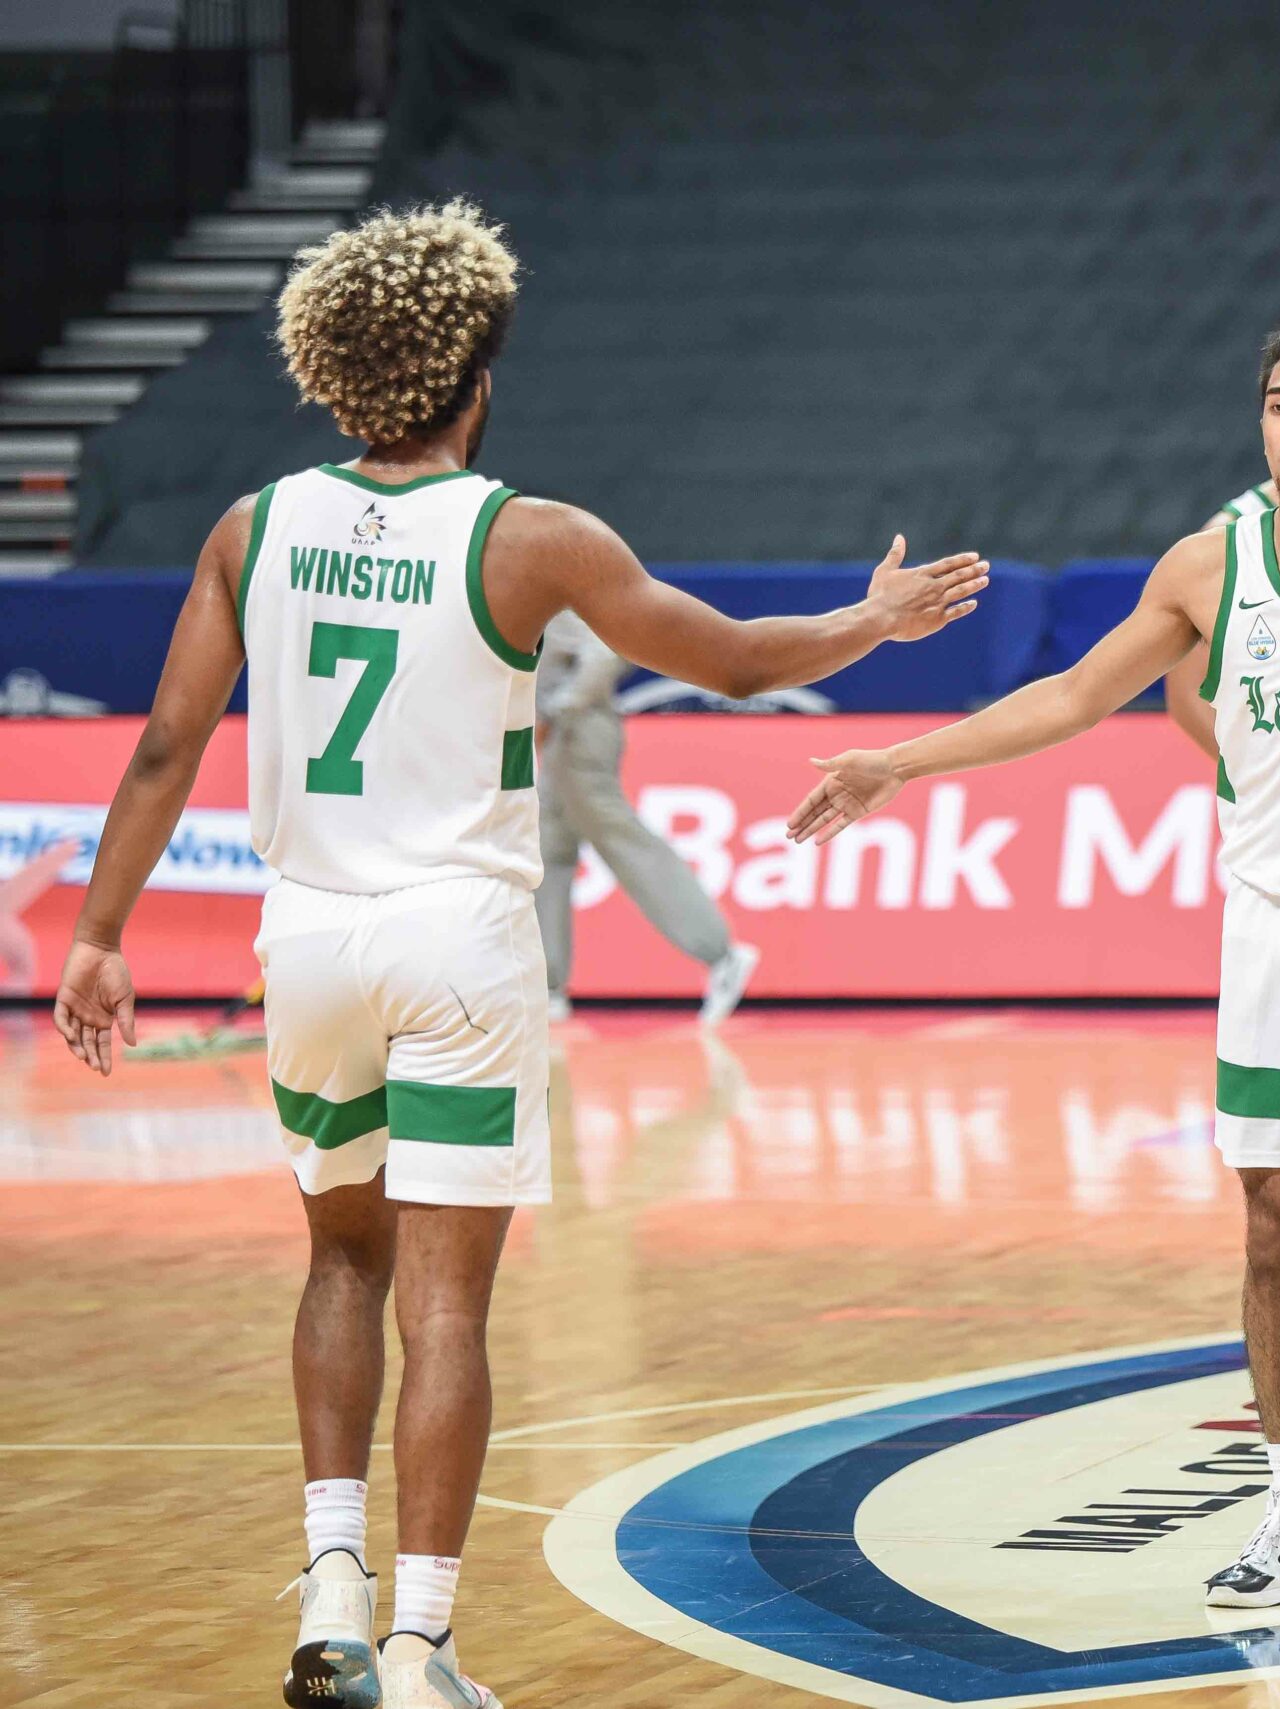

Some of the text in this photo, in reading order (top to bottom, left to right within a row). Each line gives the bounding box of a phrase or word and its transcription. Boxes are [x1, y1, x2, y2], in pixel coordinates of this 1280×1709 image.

[290, 546, 436, 605] WINSTON
[305, 621, 400, 796] 7
[637, 782, 1019, 910] Bank
[991, 1484, 1269, 1553] MALL
